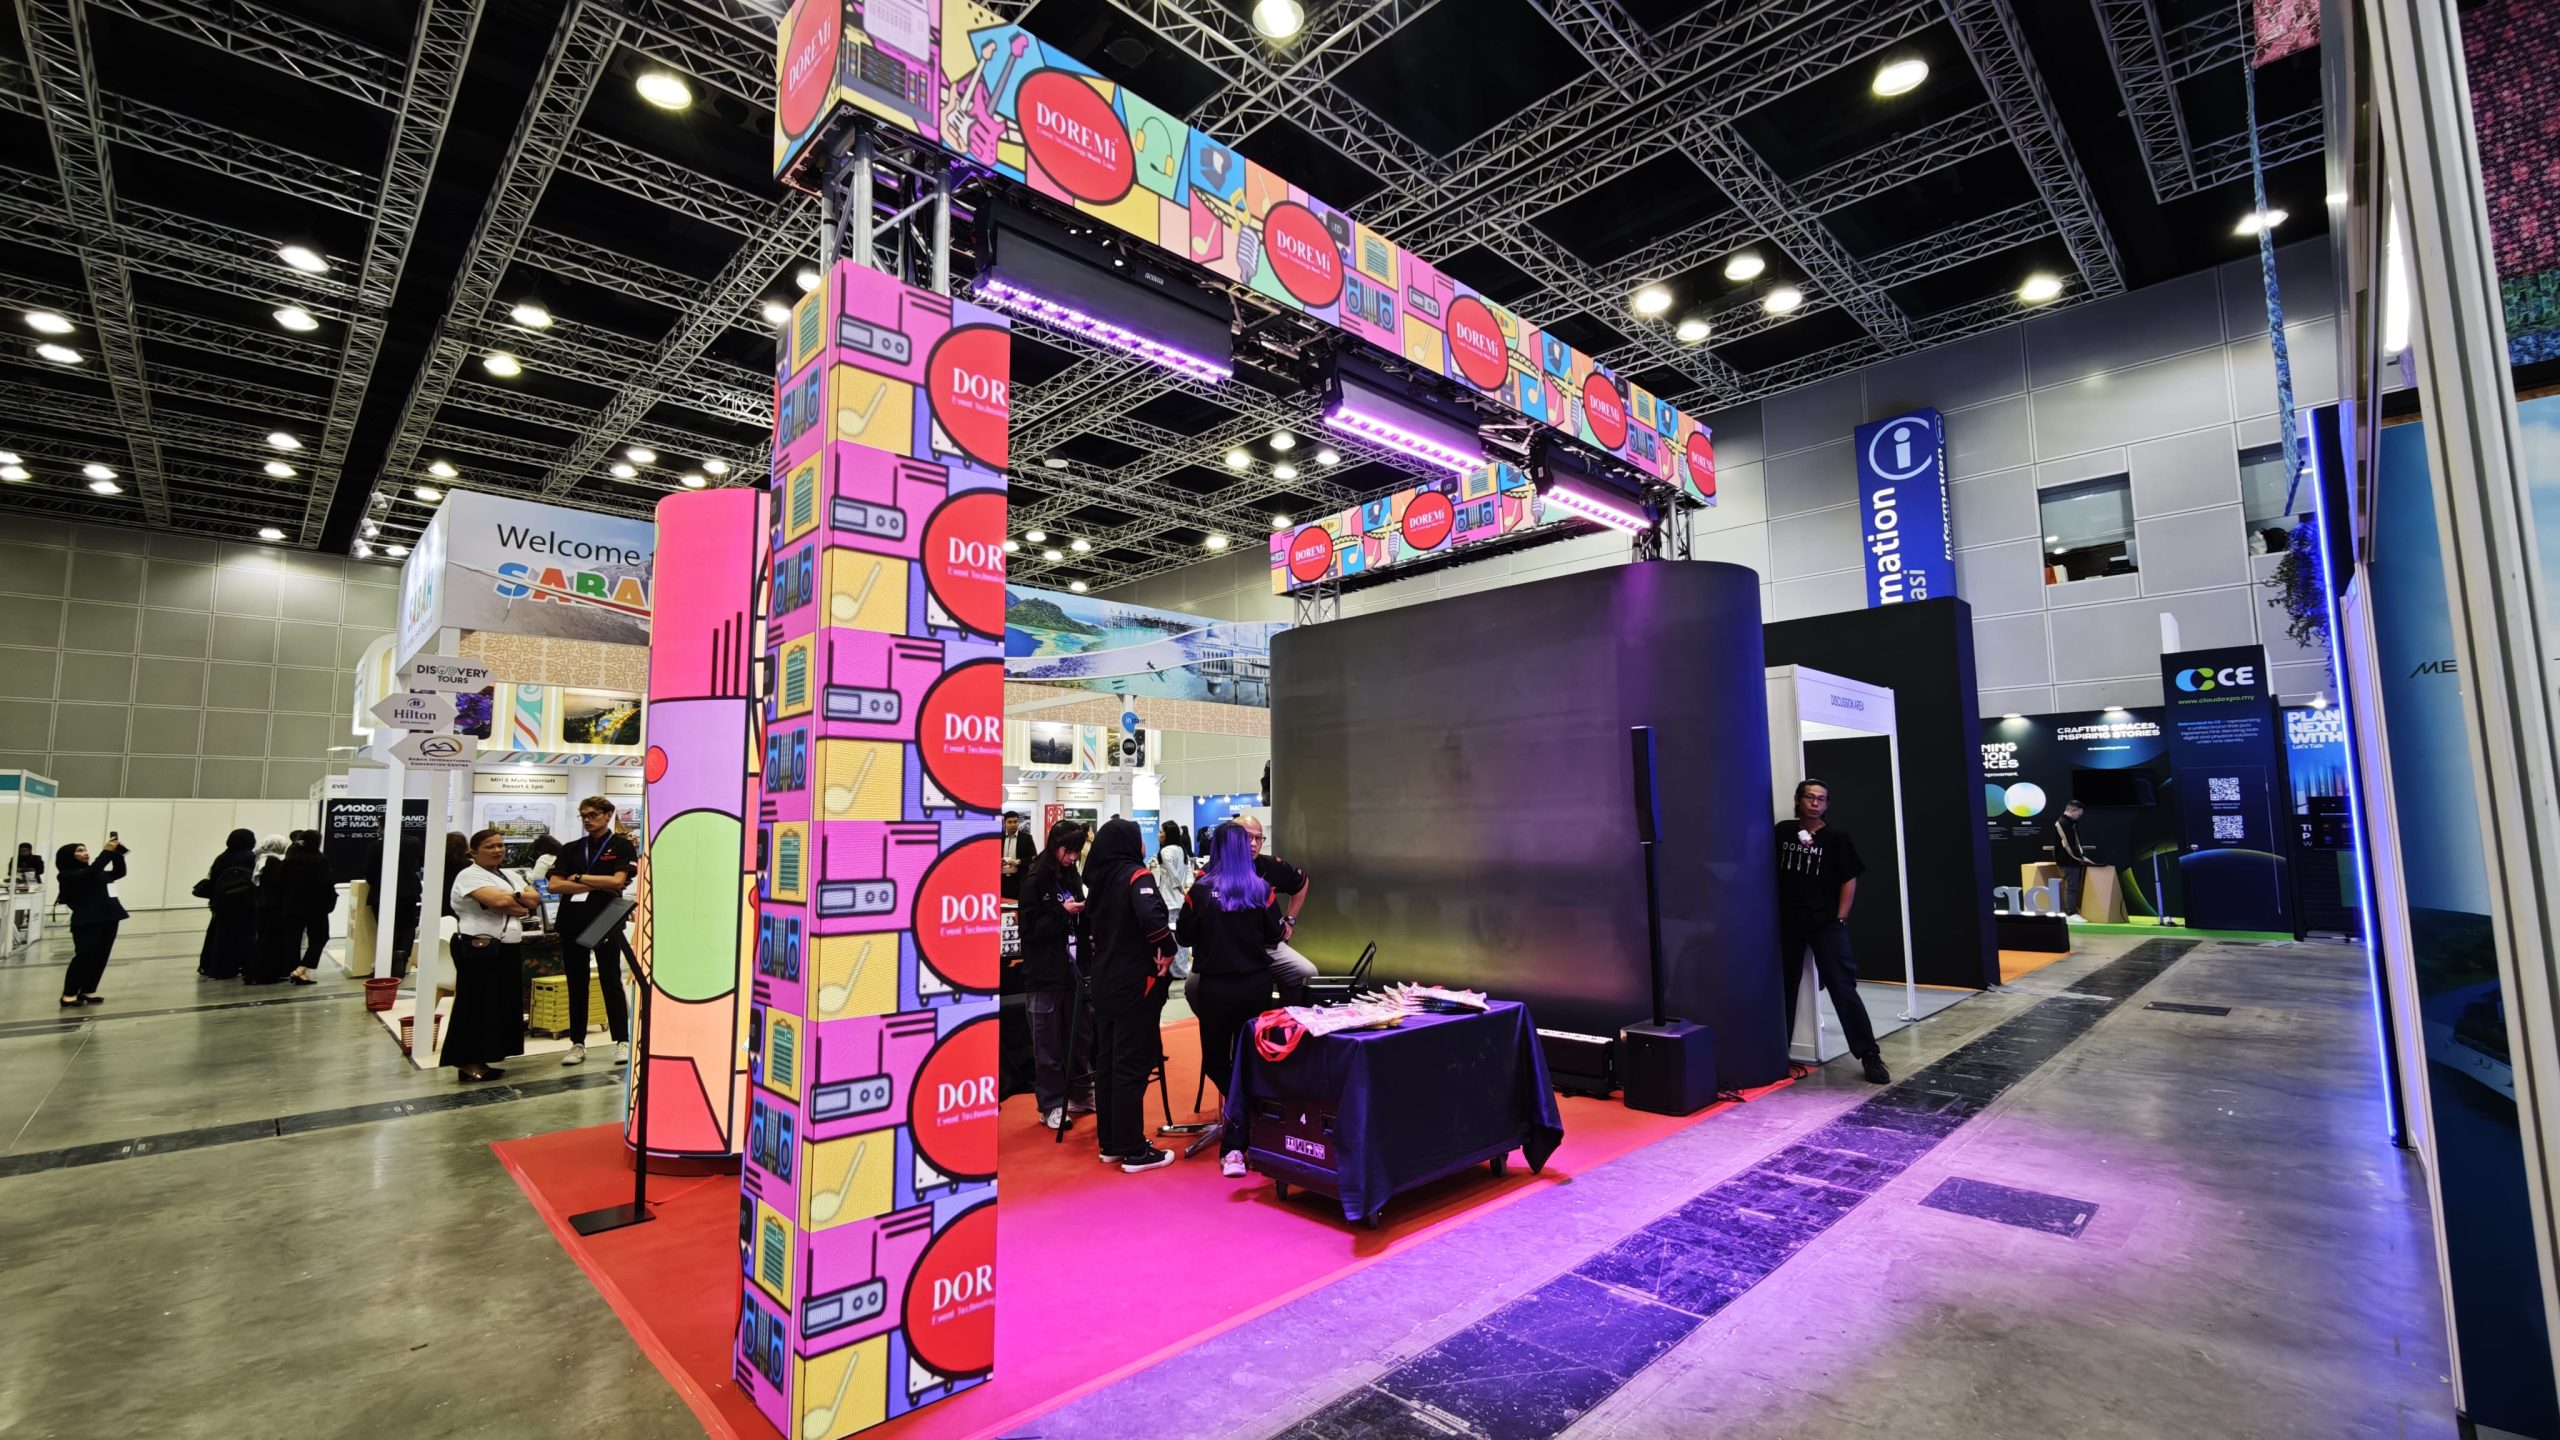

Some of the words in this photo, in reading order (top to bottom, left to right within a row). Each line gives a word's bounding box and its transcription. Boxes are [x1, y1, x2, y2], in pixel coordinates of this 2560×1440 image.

[1036, 101, 1117, 163] DOREMi
[1276, 229, 1331, 272] DOREMi
[1456, 321, 1499, 357] DOREMi
[1409, 510, 1445, 528] DOREMi
[497, 523, 641, 567] Welcome
[1295, 543, 1326, 561] DOREMi
[496, 562, 652, 609] SABA
[437, 675, 469, 684] TOURS
[2217, 666, 2255, 686] CE
[1829, 694, 1853, 709] DISCUSSION
[1853, 700, 1865, 712] AREA
[394, 708, 437, 720] Hilton
[2287, 710, 2340, 723] PLAN
[2057, 724, 2109, 734] CRAFTING
[2110, 722, 2160, 731] SPACES,
[2057, 731, 2111, 741] INSPIRING
[2112, 728, 2161, 739] STORIES
[2289, 722, 2341, 734] NEXT
[2290, 732, 2344, 744] WITH
[1300, 1113, 1307, 1125] 4
